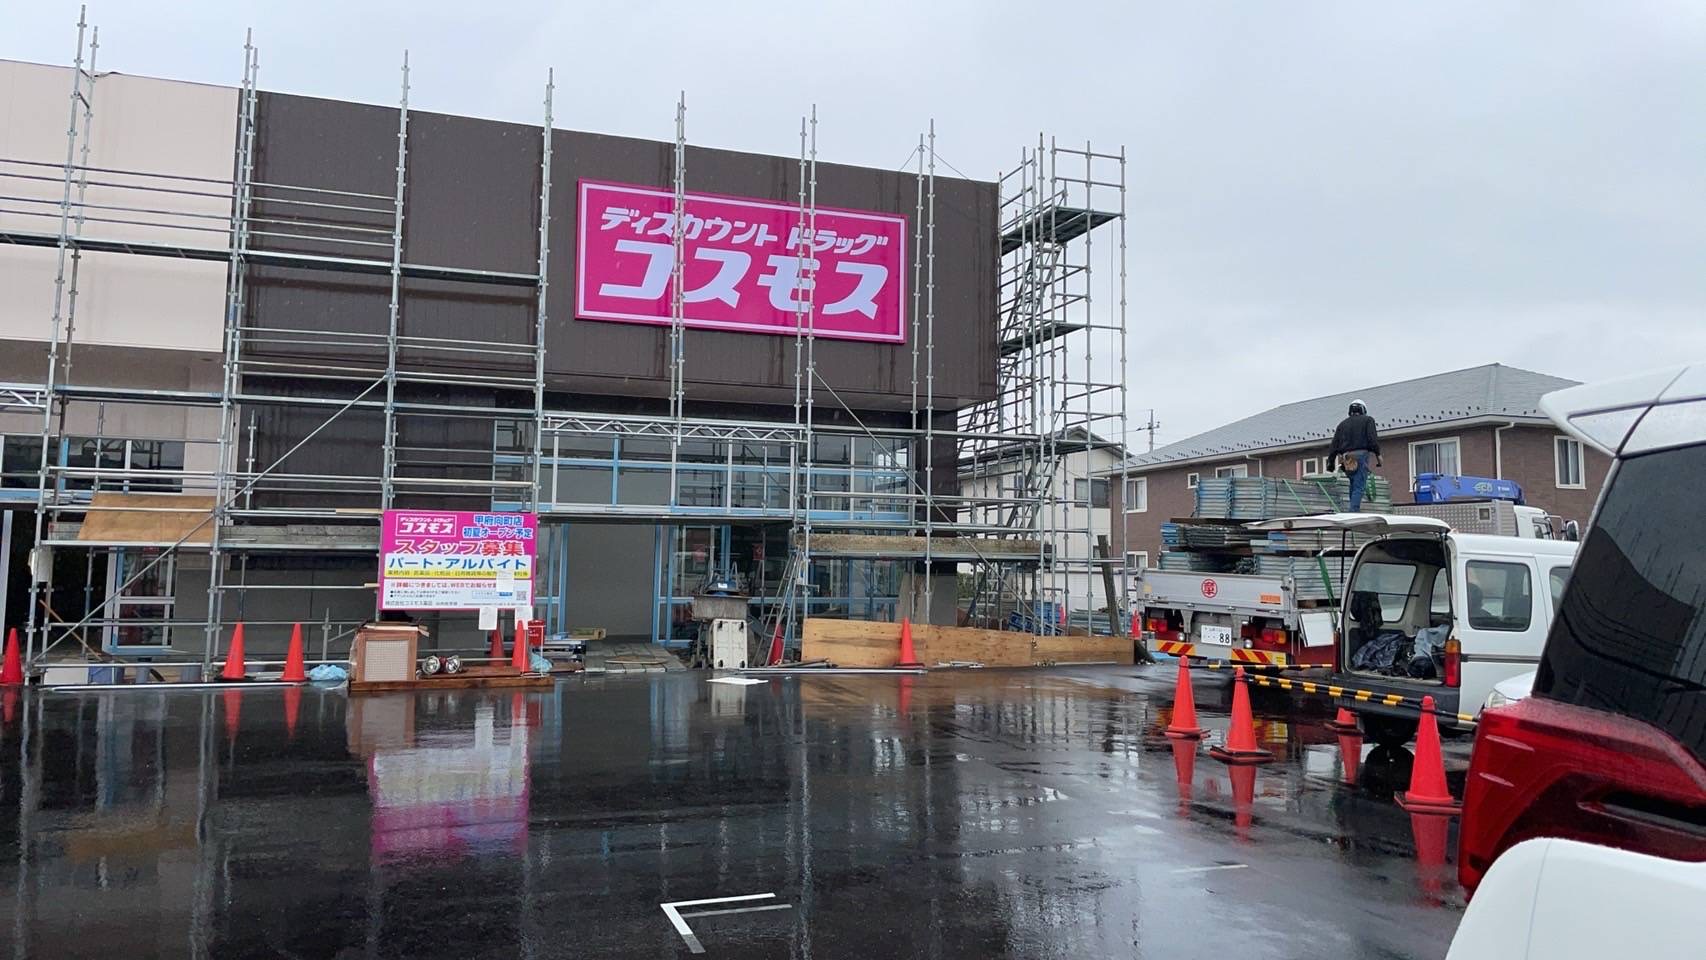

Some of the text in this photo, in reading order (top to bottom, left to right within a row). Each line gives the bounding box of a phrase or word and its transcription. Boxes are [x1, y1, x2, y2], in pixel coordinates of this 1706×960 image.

[600, 206, 889, 256] ディスカウント ドラッグ
[598, 239, 889, 320] コスモス
[474, 514, 523, 526] 甲府向町店
[399, 522, 454, 534] コスモス
[394, 540, 524, 557] スタッフ募集
[389, 557, 526, 569] パート・アルバイト
[1219, 632, 1230, 644] 88
